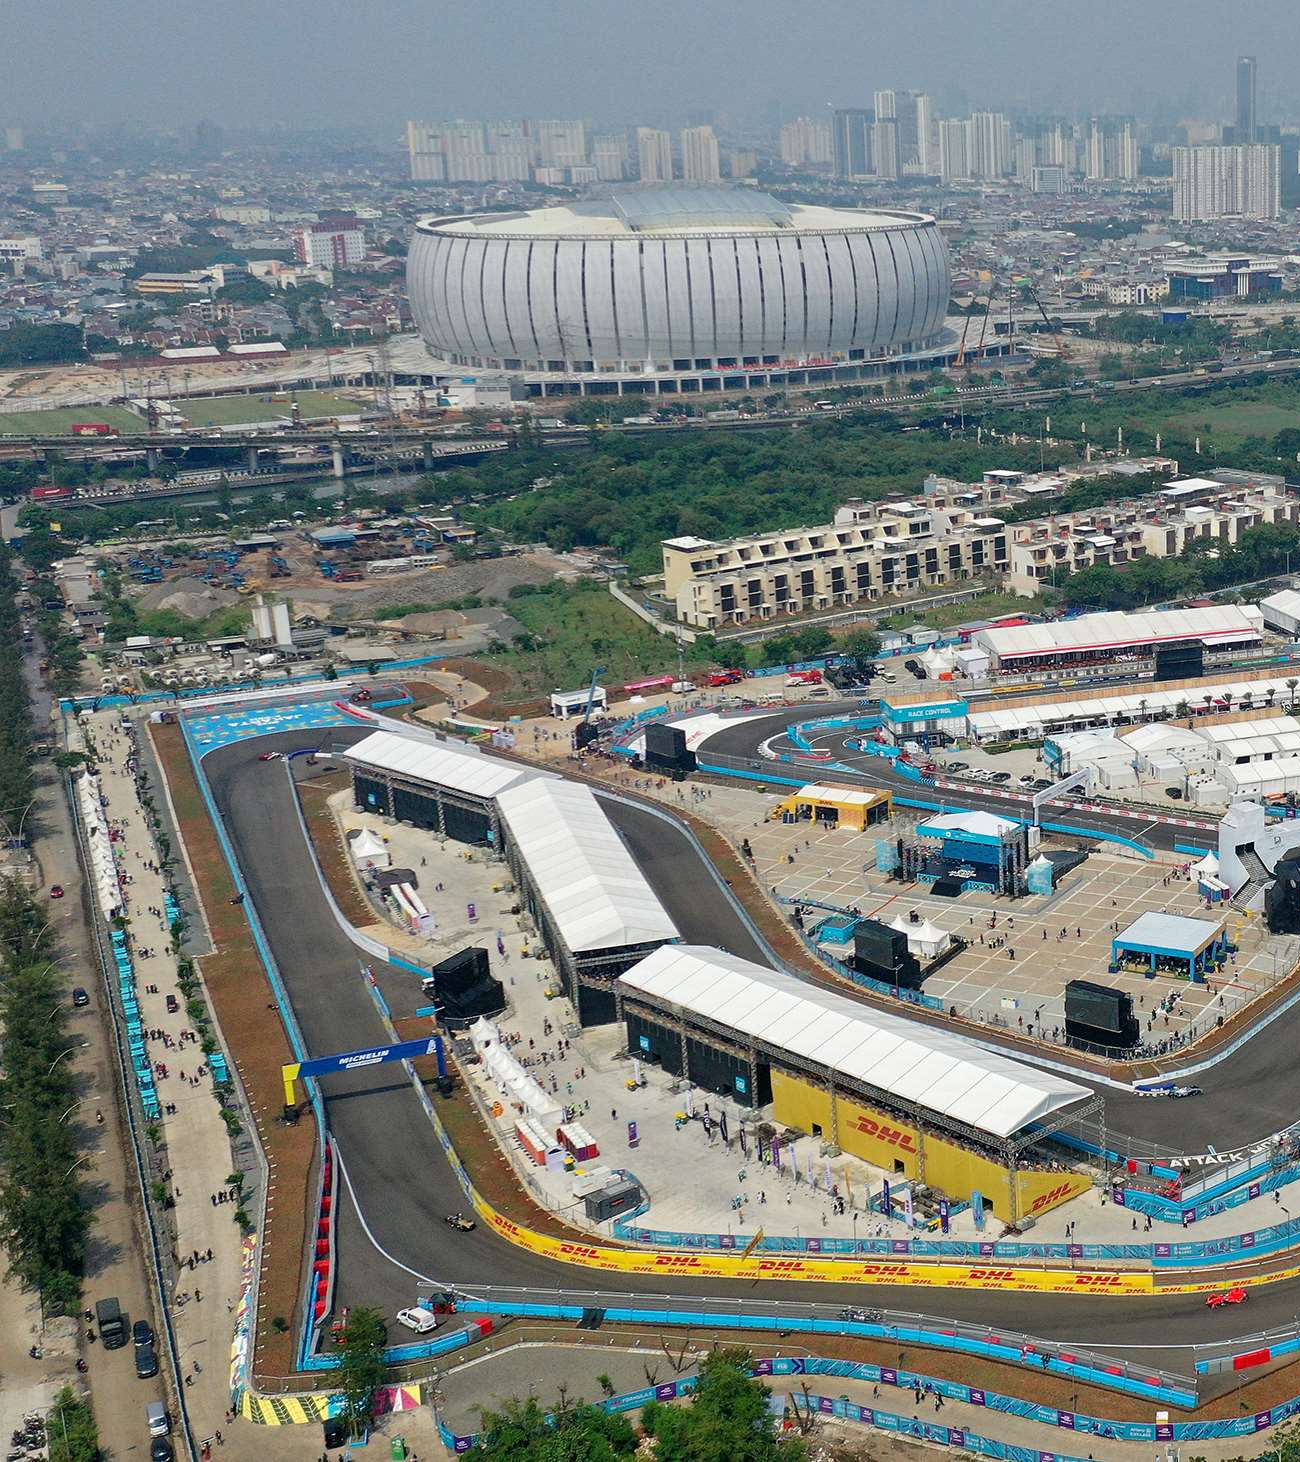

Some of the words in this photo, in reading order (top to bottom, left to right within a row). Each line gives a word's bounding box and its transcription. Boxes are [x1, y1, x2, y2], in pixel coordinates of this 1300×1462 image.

[925, 708, 952, 716] CONTROL
[338, 1050, 390, 1065] MICHELIN
[856, 1116, 917, 1154] DHL
[1169, 1151, 1245, 1168] ATTACK
[1031, 1183, 1072, 1211] DHL
[494, 1216, 520, 1236] DHL
[559, 1243, 600, 1259] DHL
[655, 1255, 702, 1267] DHL
[759, 1260, 806, 1271] DHL
[863, 1265, 910, 1276] DHL
[968, 1269, 1016, 1280] DHL
[1266, 1272, 1286, 1281] DHL
[1075, 1275, 1122, 1286] DHL
